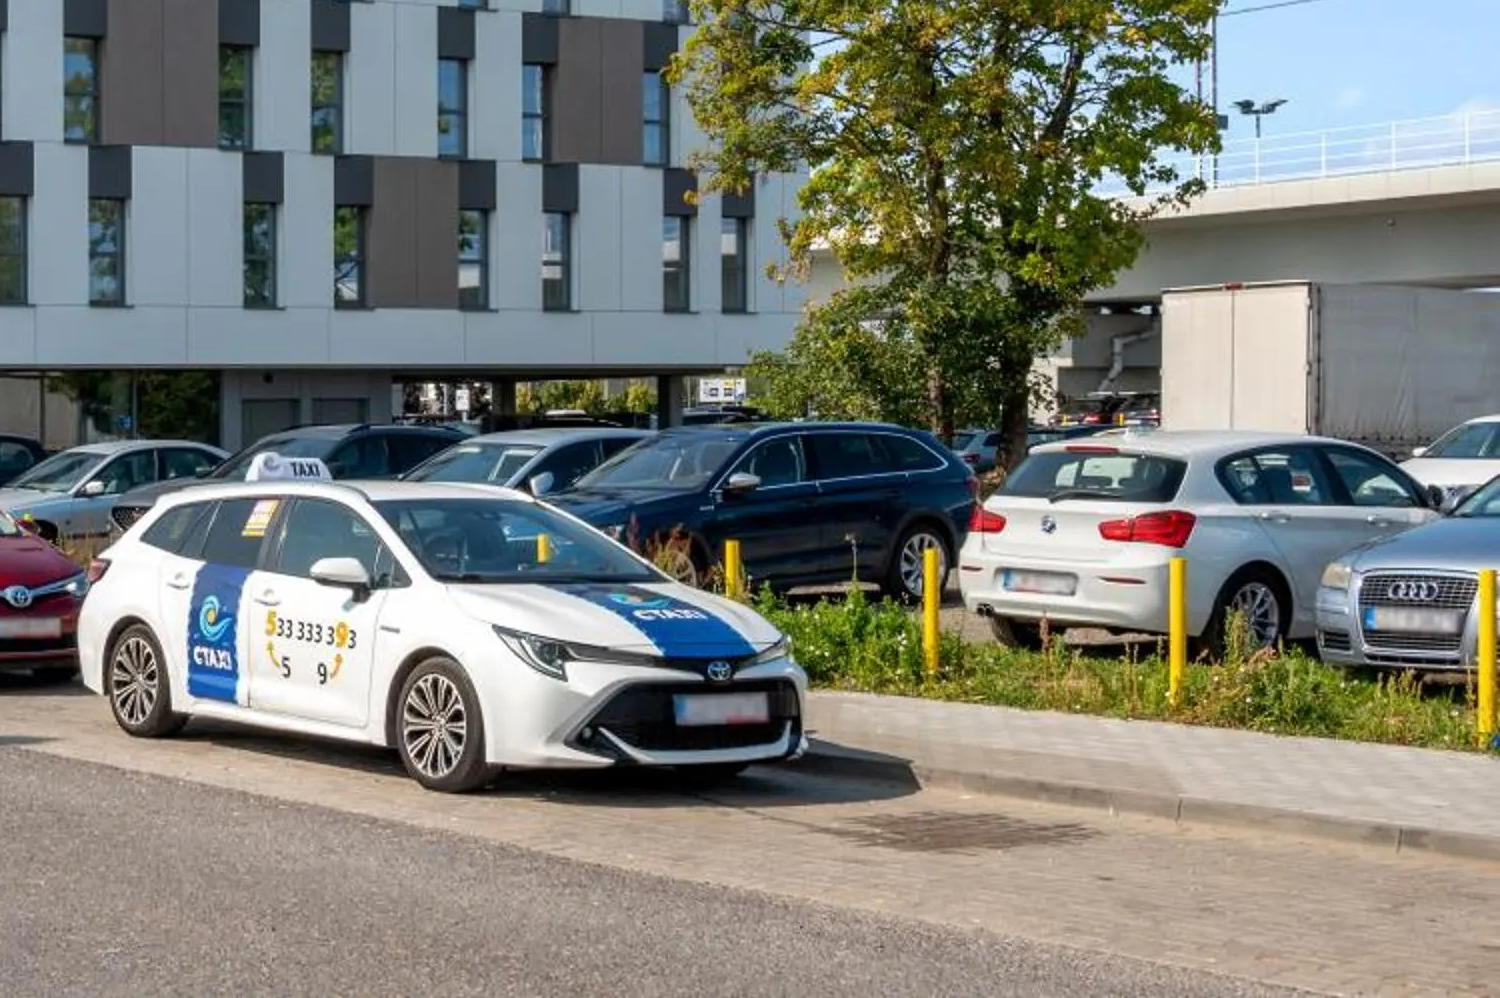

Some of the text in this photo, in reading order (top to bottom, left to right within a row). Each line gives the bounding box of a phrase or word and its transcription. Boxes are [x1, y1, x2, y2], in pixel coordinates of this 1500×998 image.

[290, 462, 320, 476] TAXI
[265, 610, 357, 649] 533 333 393
[281, 656, 292, 679] 5
[317, 662, 327, 685] 9
